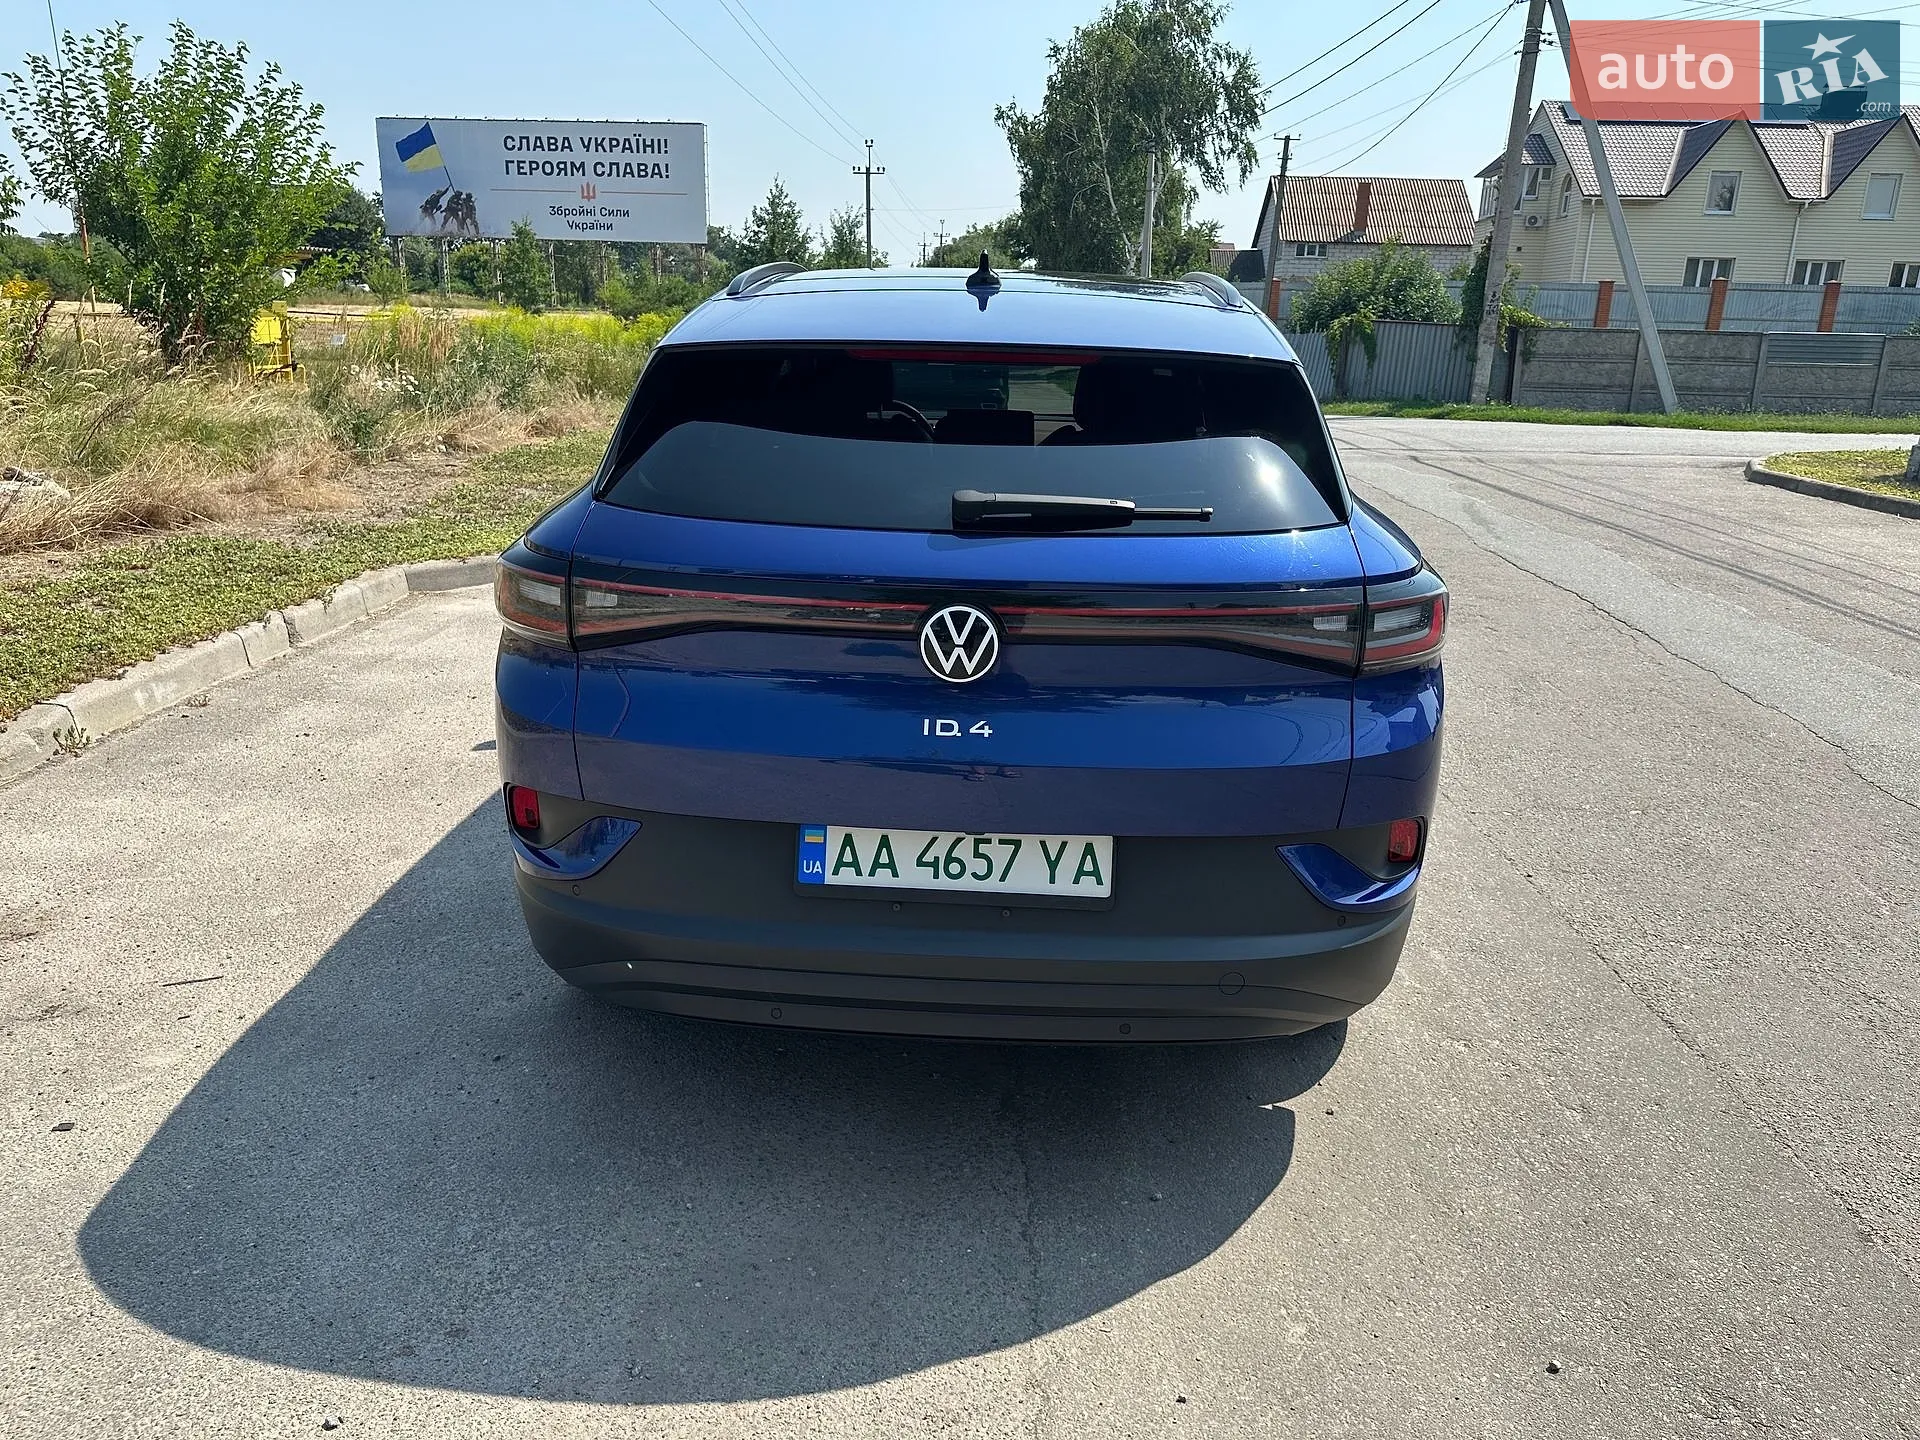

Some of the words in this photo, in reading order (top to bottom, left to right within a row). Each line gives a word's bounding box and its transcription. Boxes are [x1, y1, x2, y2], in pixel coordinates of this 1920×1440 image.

[503, 135, 574, 152] СЛАВА
[579, 133, 669, 154] УКРАЇНІ!
[504, 159, 586, 177] ГЕРОЯМ
[593, 161, 670, 179] СЛАВА!
[549, 205, 596, 218] Збройні
[599, 206, 630, 217] Сили
[566, 219, 613, 232] України
[923, 608, 997, 678] VW
[803, 859, 823, 874] UA
[831, 833, 900, 878] AA
[915, 836, 1023, 882] 4657
[1039, 840, 1104, 886] YA
